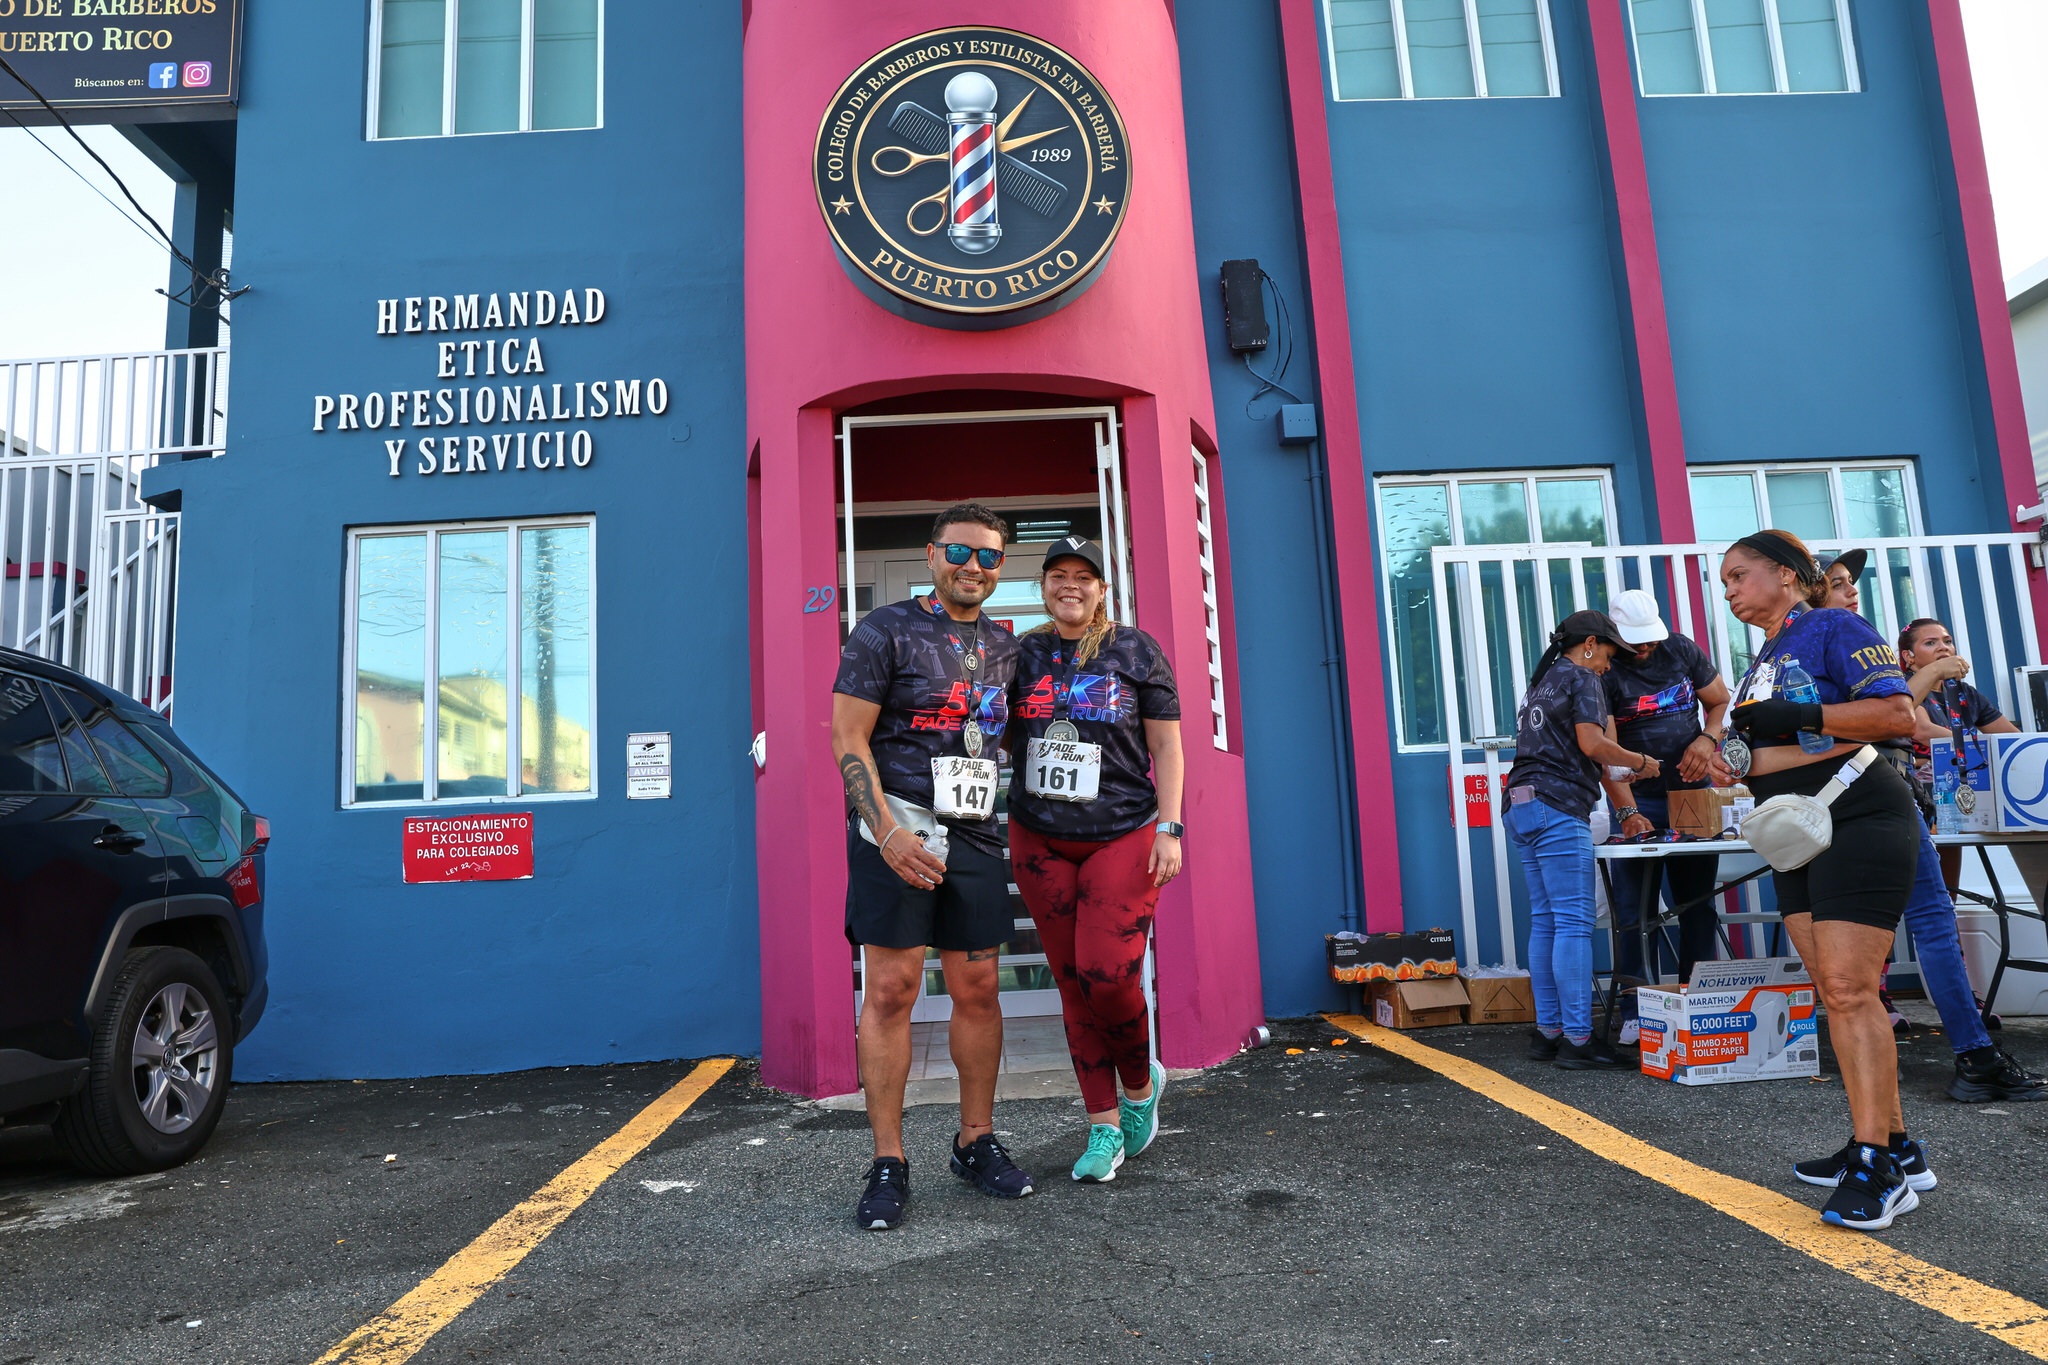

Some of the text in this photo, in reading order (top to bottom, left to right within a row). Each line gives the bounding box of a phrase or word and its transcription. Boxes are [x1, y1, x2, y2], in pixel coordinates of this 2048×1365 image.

[24, 0, 62, 17] DE
[72, 0, 217, 17] BARBEROS
[102, 27, 173, 51] RICO
[74, 77, 144, 88] Búscanos en:
[828, 40, 1119, 182] COLEGIO DE BARBEROS Y ESTILISTAS EN BARBERÍA
[1030, 148, 1072, 162] 1989
[869, 248, 1078, 299] PUERTO RICO
[376, 288, 606, 334] HERMANDAD
[437, 337, 545, 378] ETICA
[312, 378, 669, 431] PROFESIONALISMO
[384, 430, 593, 476] Y SERVICIO
[803, 587, 835, 614] 29
[1850, 644, 1900, 670] TRIB
[1026, 674, 1105, 706] 5K
[1070, 706, 1116, 723] RUN
[910, 715, 962, 730] FADE
[1048, 742, 1077, 753] FADE
[960, 760, 984, 771] FADE
[1060, 753, 1085, 763] RUN
[634, 767, 664, 776] AVISO
[973, 770, 990, 780] RUN
[1038, 765, 1078, 791] 161
[952, 784, 988, 809] 147
[408, 817, 528, 834] ESTACIONAMIENTO
[431, 831, 504, 845] EXCLUSIVO
[416, 844, 519, 859] PARA COLEGIADOS
[445, 862, 469, 876] LEY 22
[1429, 935, 1452, 943] CITRUS
[1698, 975, 1766, 989] MARATHON
[1639, 991, 1663, 1000] MARATHON
[1688, 996, 1736, 1006] MARATHON
[1640, 1018, 1653, 1028] 6,000
[1692, 1017, 1722, 1032] 6,000
[1789, 1022, 1815, 1033] 6 ROLLS
[1692, 1037, 1742, 1049] JUMBO 2-PLY
[1692, 1046, 1745, 1058] TOILET PAPER
